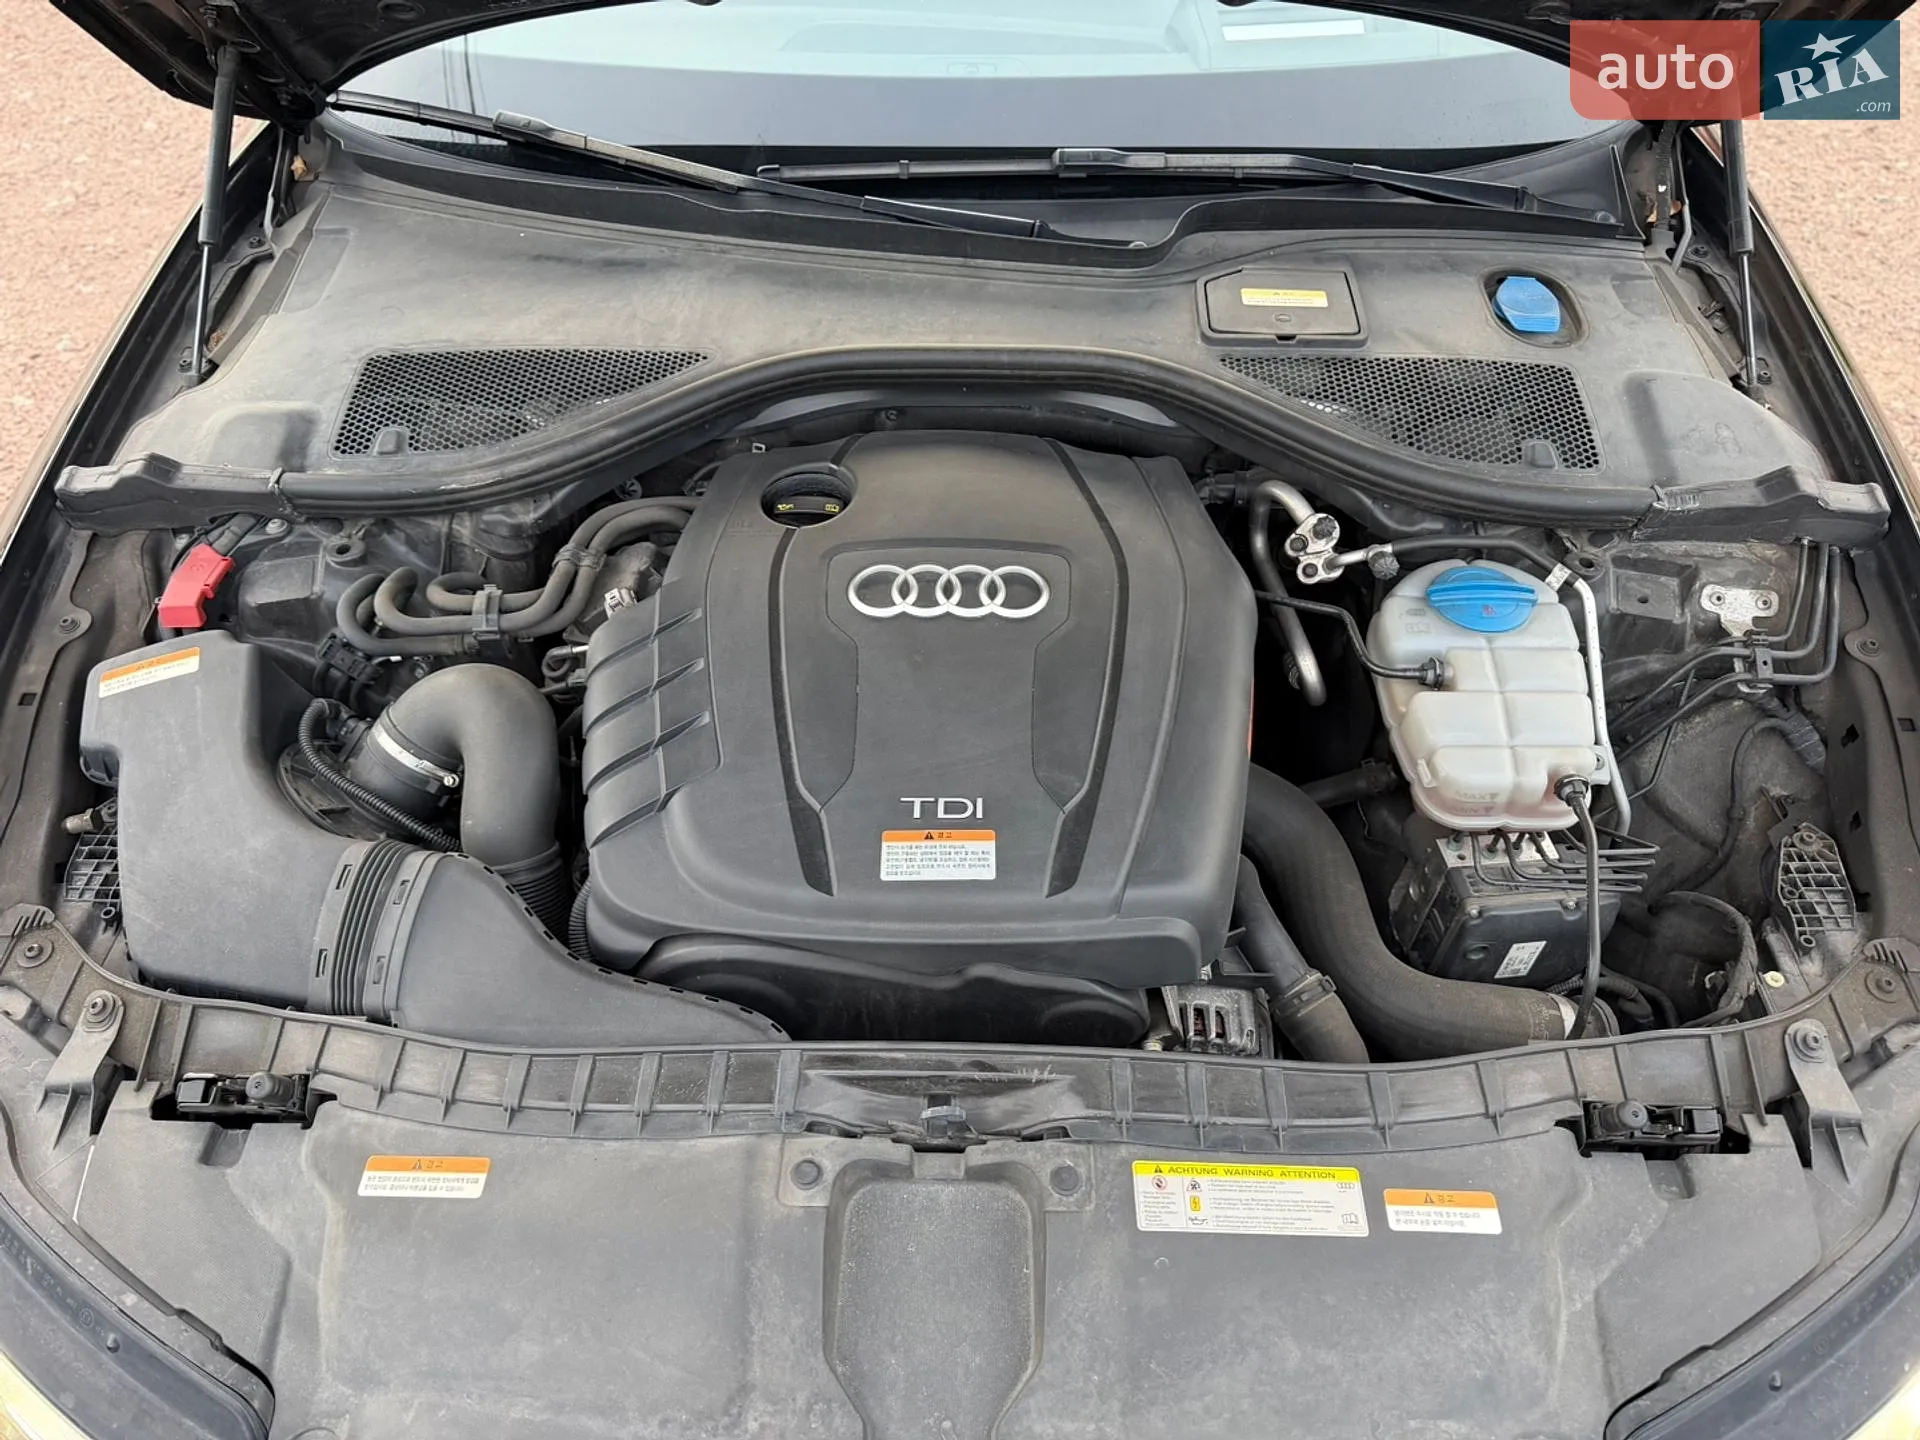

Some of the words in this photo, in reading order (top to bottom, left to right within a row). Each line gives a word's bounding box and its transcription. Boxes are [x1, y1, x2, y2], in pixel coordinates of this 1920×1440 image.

[900, 797, 983, 819] TDI
[1168, 1165, 1218, 1175] ACHTUNG
[1223, 1167, 1274, 1178] WARNING
[1279, 1169, 1336, 1180] ATTENTION
